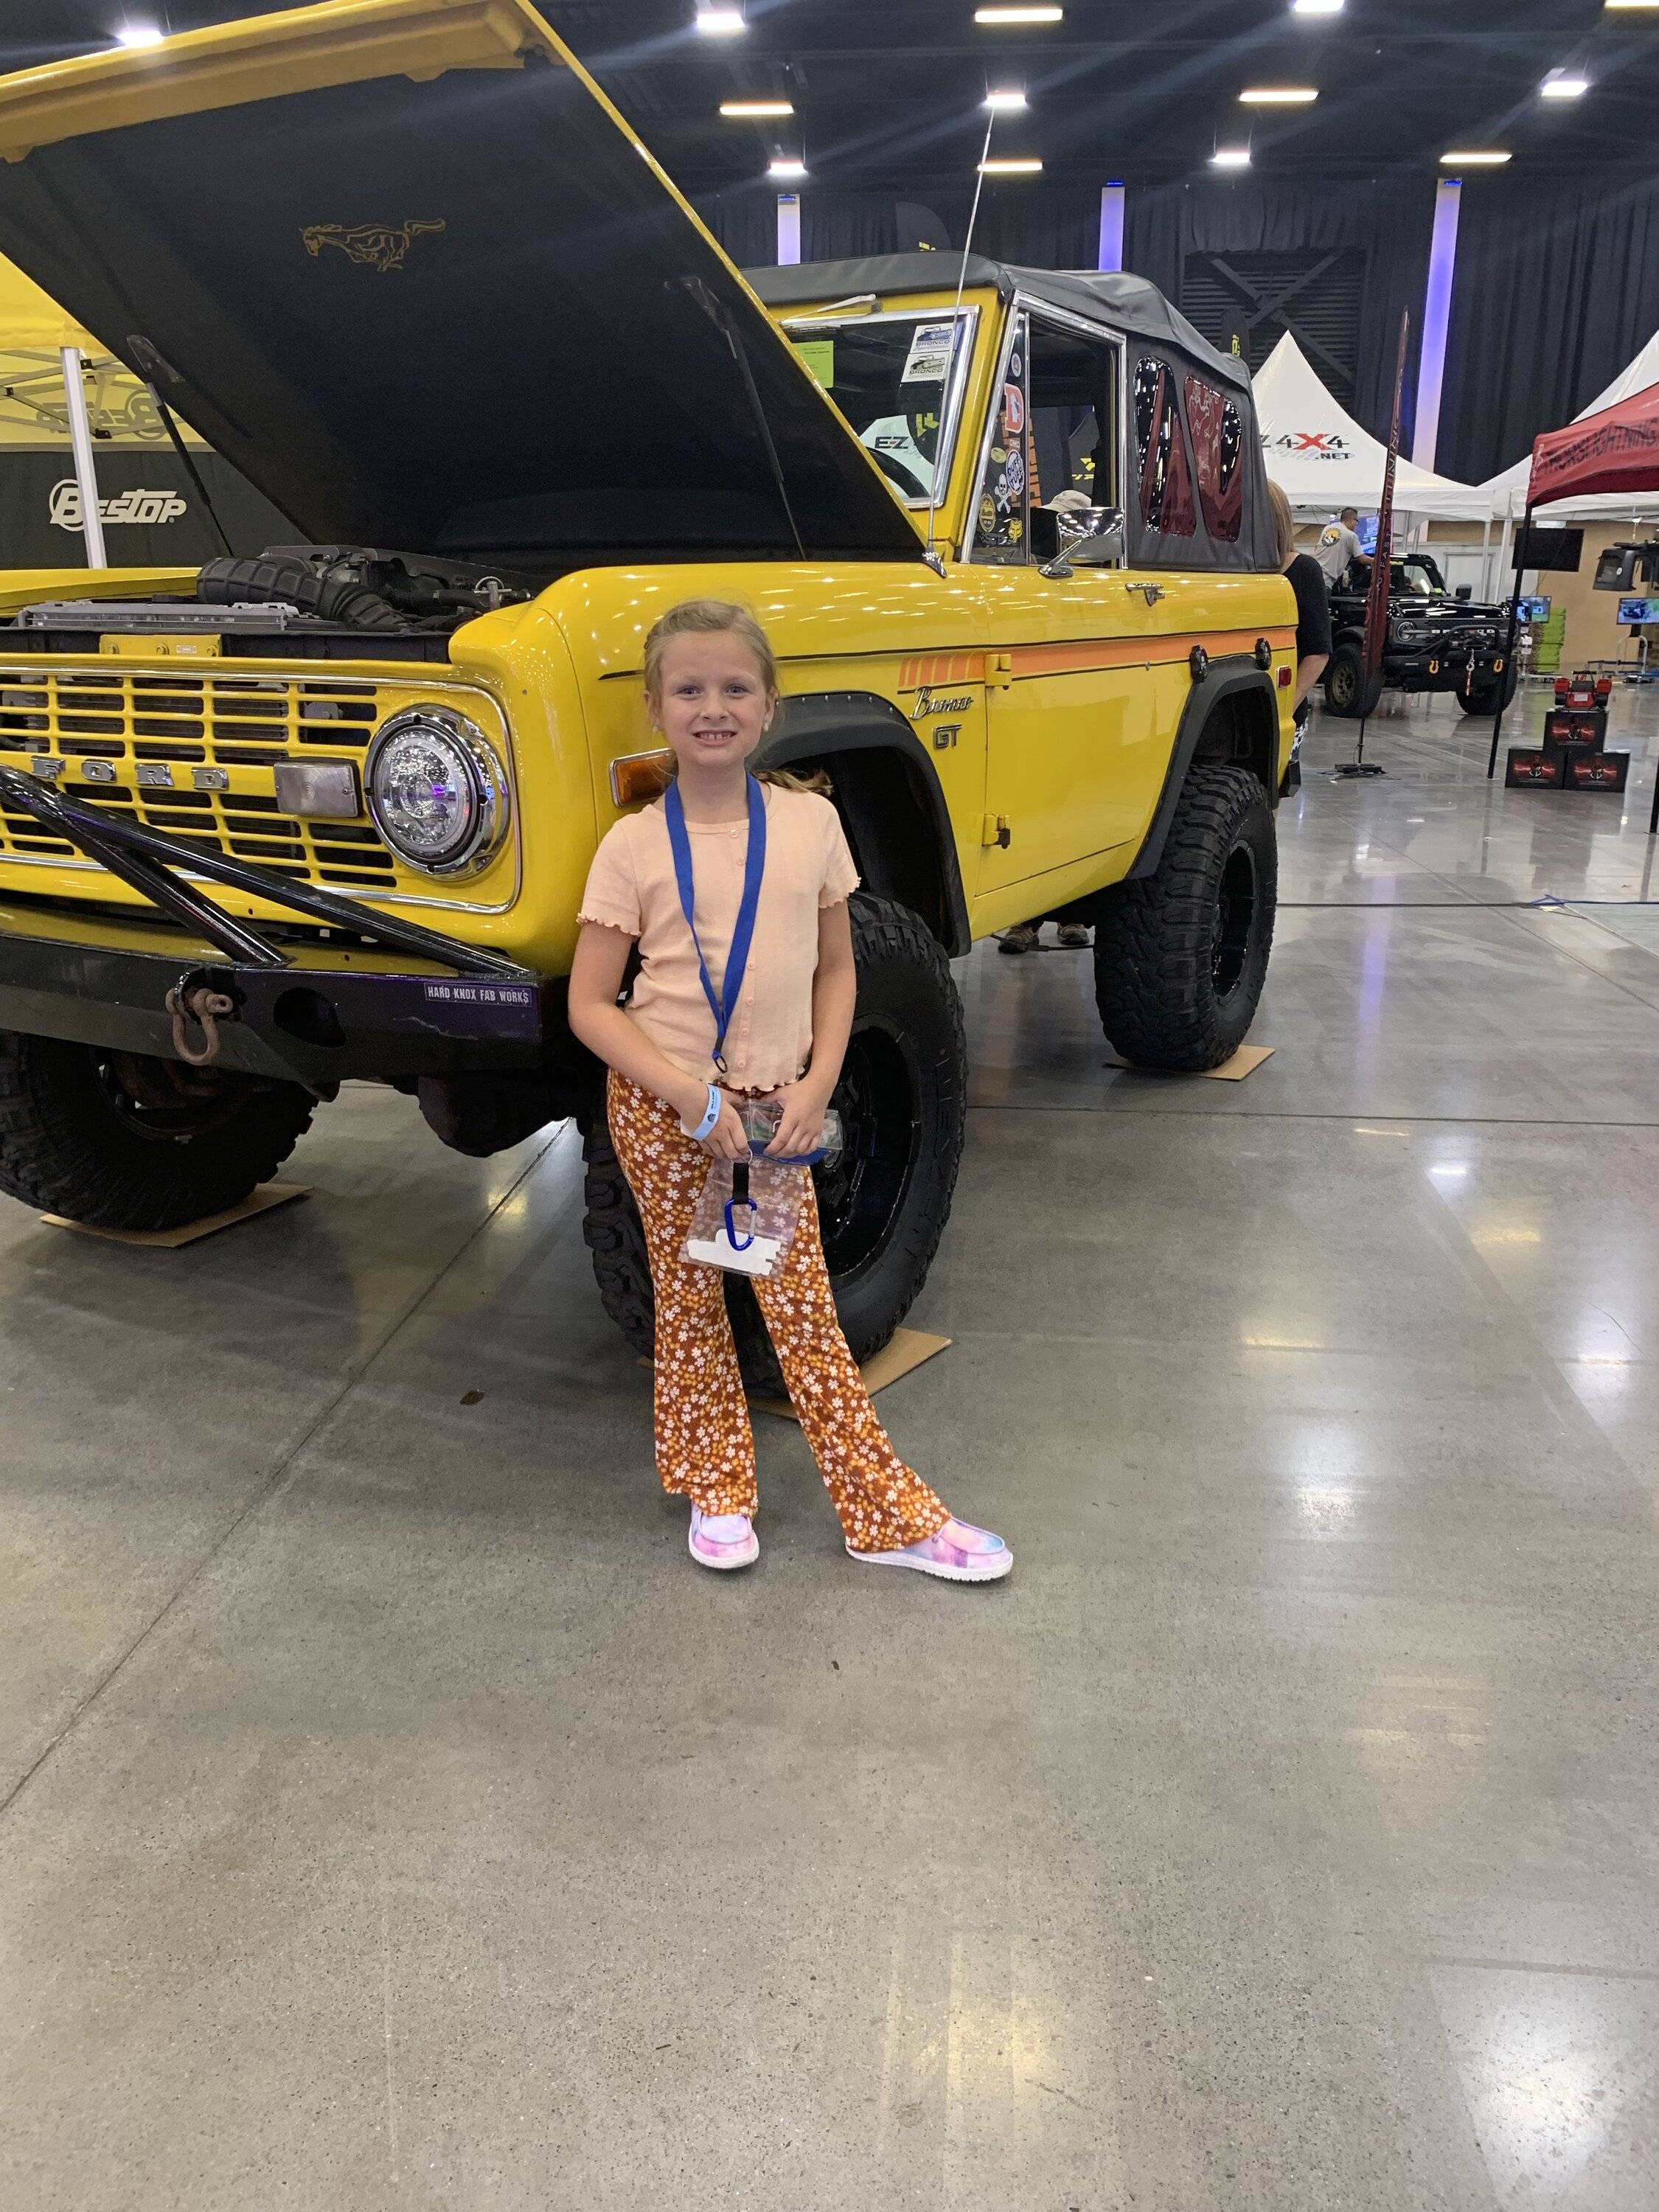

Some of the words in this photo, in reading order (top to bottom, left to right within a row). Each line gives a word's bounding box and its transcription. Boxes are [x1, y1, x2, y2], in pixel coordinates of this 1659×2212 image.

[932, 723, 962, 749] GT
[30, 756, 229, 791] FORD
[428, 986, 451, 998] HARD
[453, 988, 476, 1001] KNOX
[480, 990, 496, 1001] FAB
[499, 991, 529, 1004] WORKS
